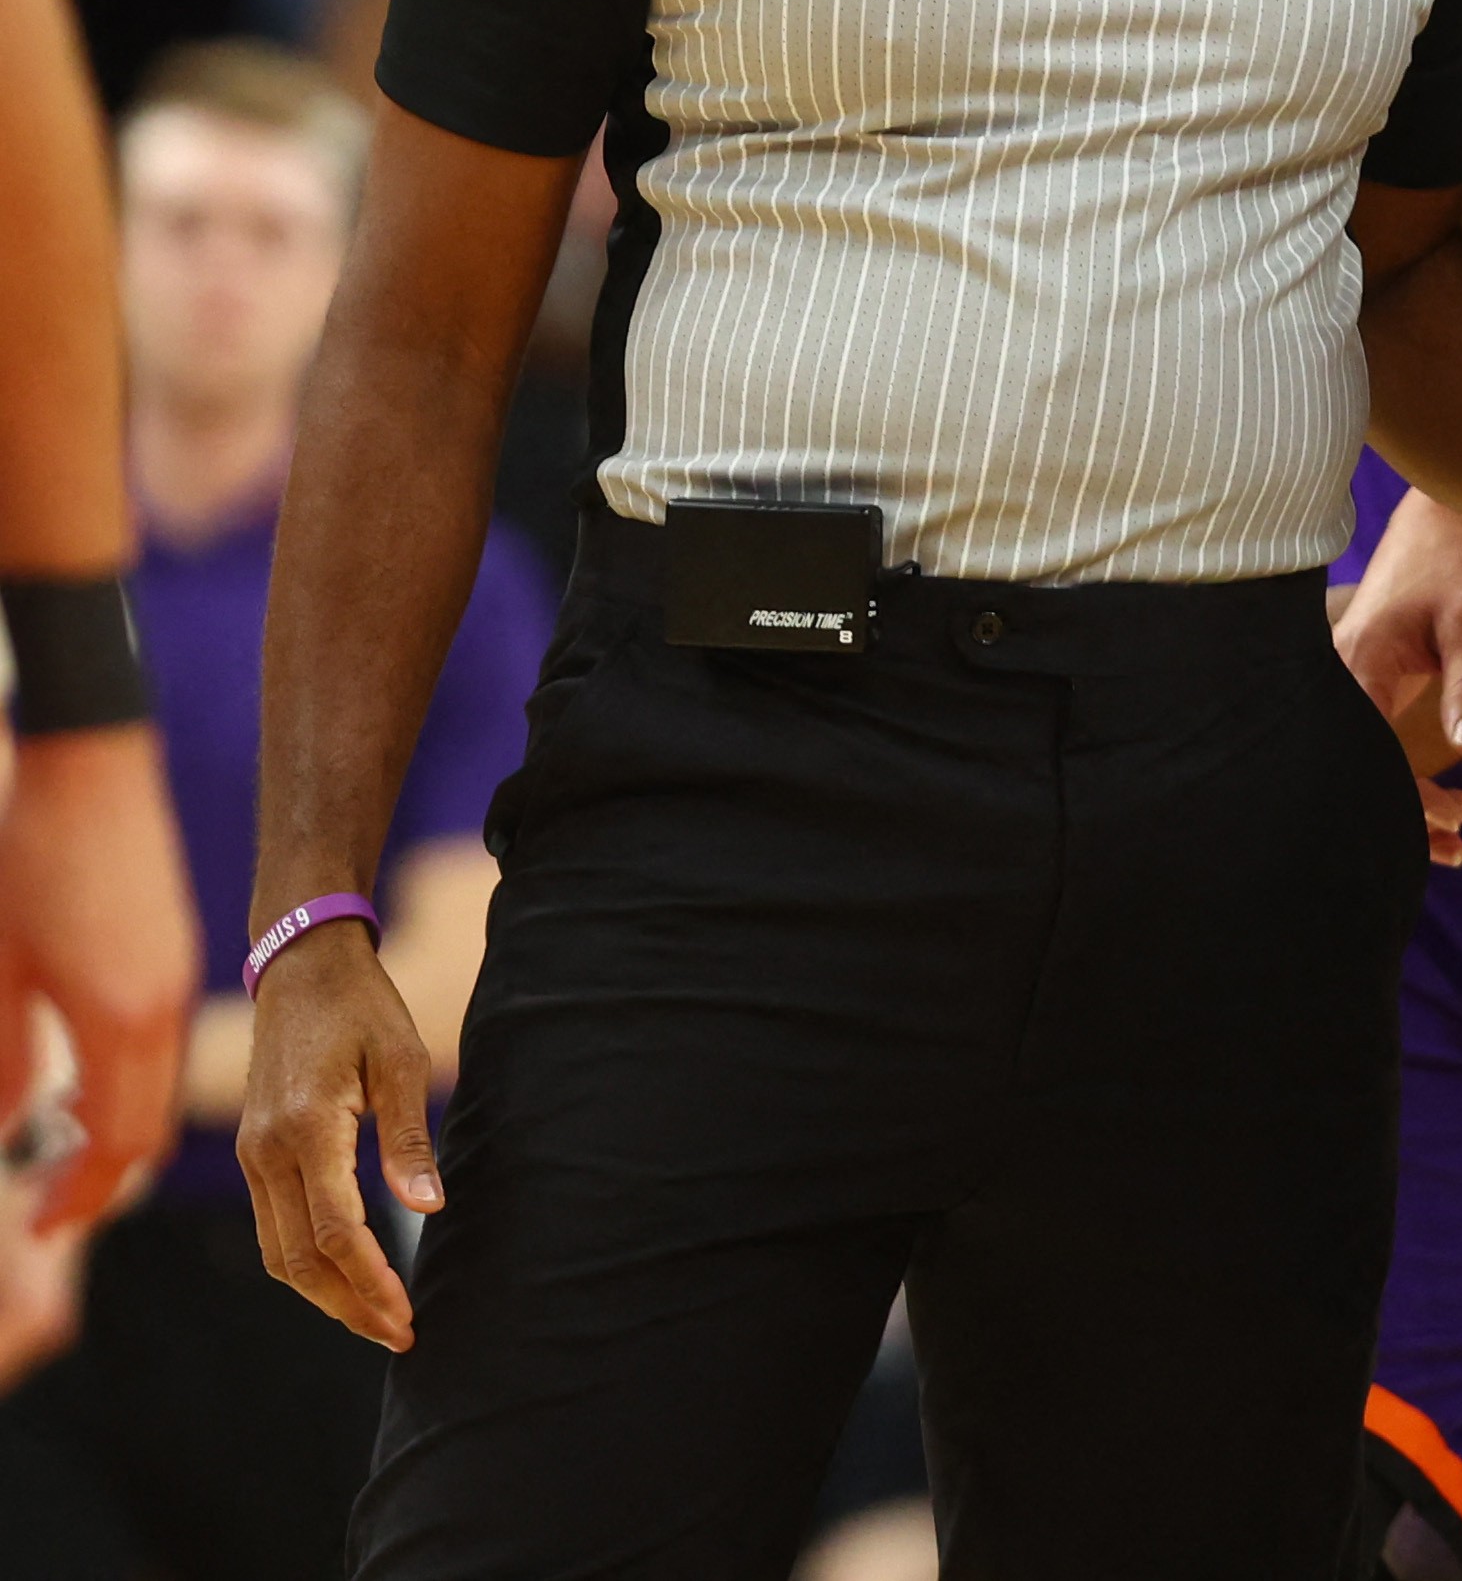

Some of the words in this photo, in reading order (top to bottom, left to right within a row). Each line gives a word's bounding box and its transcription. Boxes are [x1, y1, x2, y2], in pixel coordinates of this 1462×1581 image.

[748, 609, 815, 629] PRECISION
[295, 907, 311, 928] 6
[248, 916, 296, 974] STRONG
